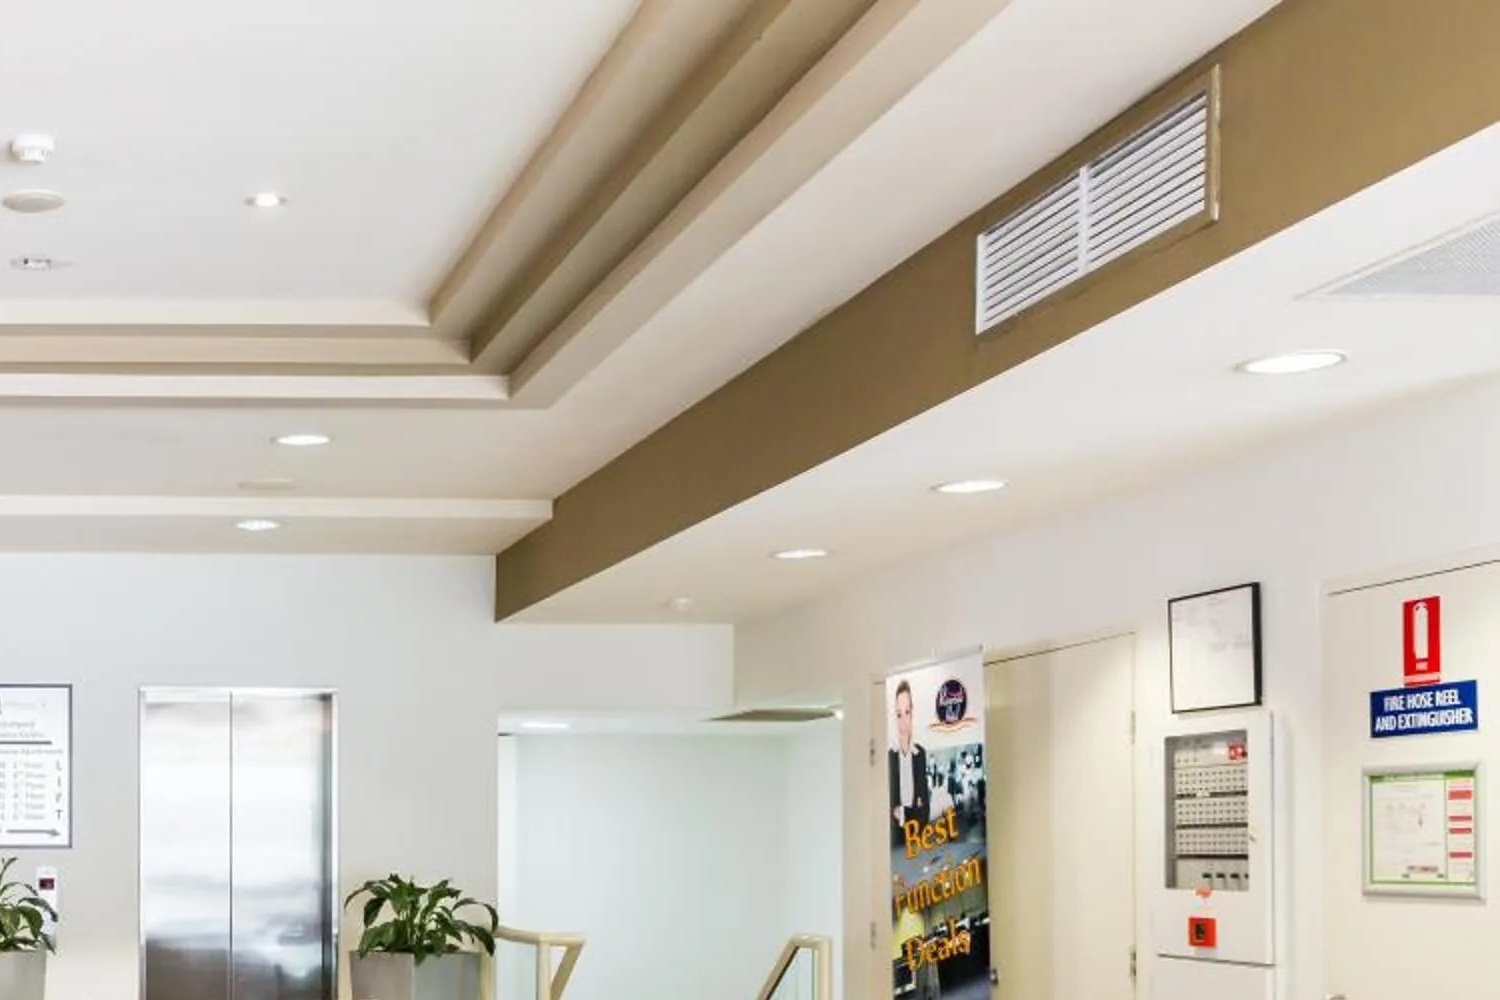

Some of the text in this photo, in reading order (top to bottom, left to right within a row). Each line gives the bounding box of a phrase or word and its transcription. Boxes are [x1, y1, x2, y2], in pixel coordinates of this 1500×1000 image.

[1374, 707, 1474, 732] AND EXTINGUISHER
[1383, 688, 1462, 712] FIRE HOSE REEL
[902, 806, 959, 860] Best
[893, 855, 982, 918] Function
[902, 917, 970, 971] Deals
